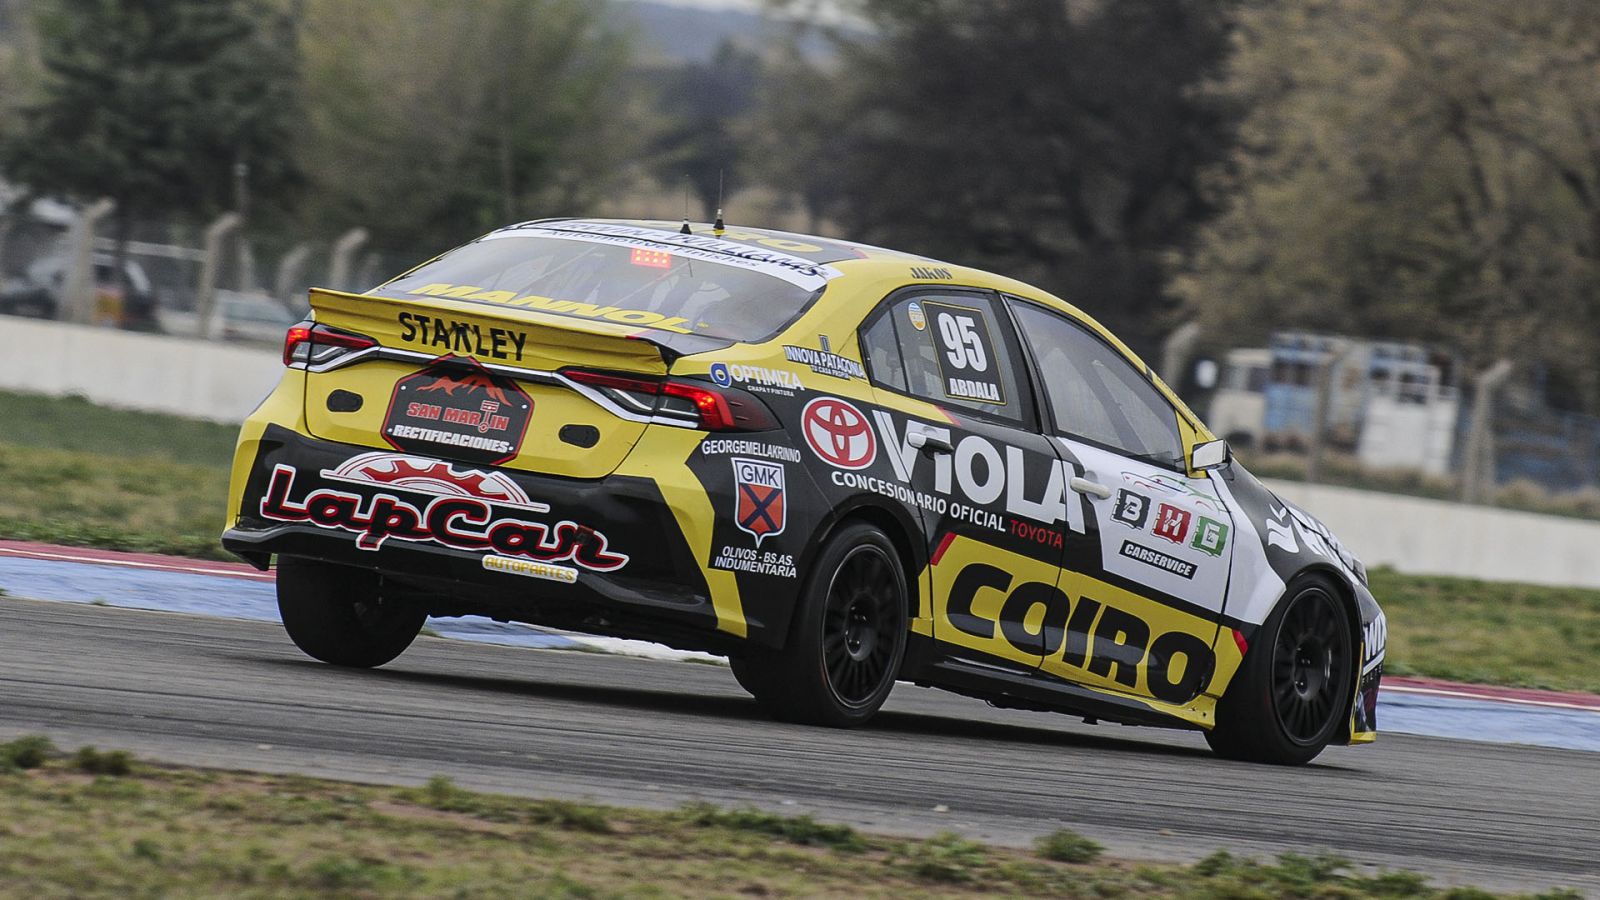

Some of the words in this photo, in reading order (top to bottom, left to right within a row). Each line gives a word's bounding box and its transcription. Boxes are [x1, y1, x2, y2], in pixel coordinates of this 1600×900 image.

[542, 230, 668, 250] Automotive
[674, 246, 757, 268] Finishes
[405, 283, 693, 335] MANNOL
[398, 312, 527, 362] STANLEY
[938, 312, 988, 372] 95
[730, 364, 805, 391] OPTIMIZA
[949, 378, 1000, 401] ABDALA
[406, 402, 442, 421] SAN
[392, 425, 510, 453] RECTIFICACIONES
[702, 440, 801, 463] GEORGEMELLAKRINNO
[741, 464, 780, 487] GMK
[872, 409, 1086, 535] VIOLA
[260, 464, 629, 572] LapCar
[831, 470, 947, 514] CONCESIONARIO
[950, 502, 1006, 533] OFICIAL
[1010, 519, 1064, 549] TOYOTA
[484, 556, 575, 581] AUTOPARTES
[715, 556, 798, 578] INDUMENTARIA
[722, 546, 757, 560] OLIVOS
[763, 551, 794, 566] BS.AS.
[1124, 543, 1193, 576] CARSERVICE
[946, 562, 1216, 702] COIRO
